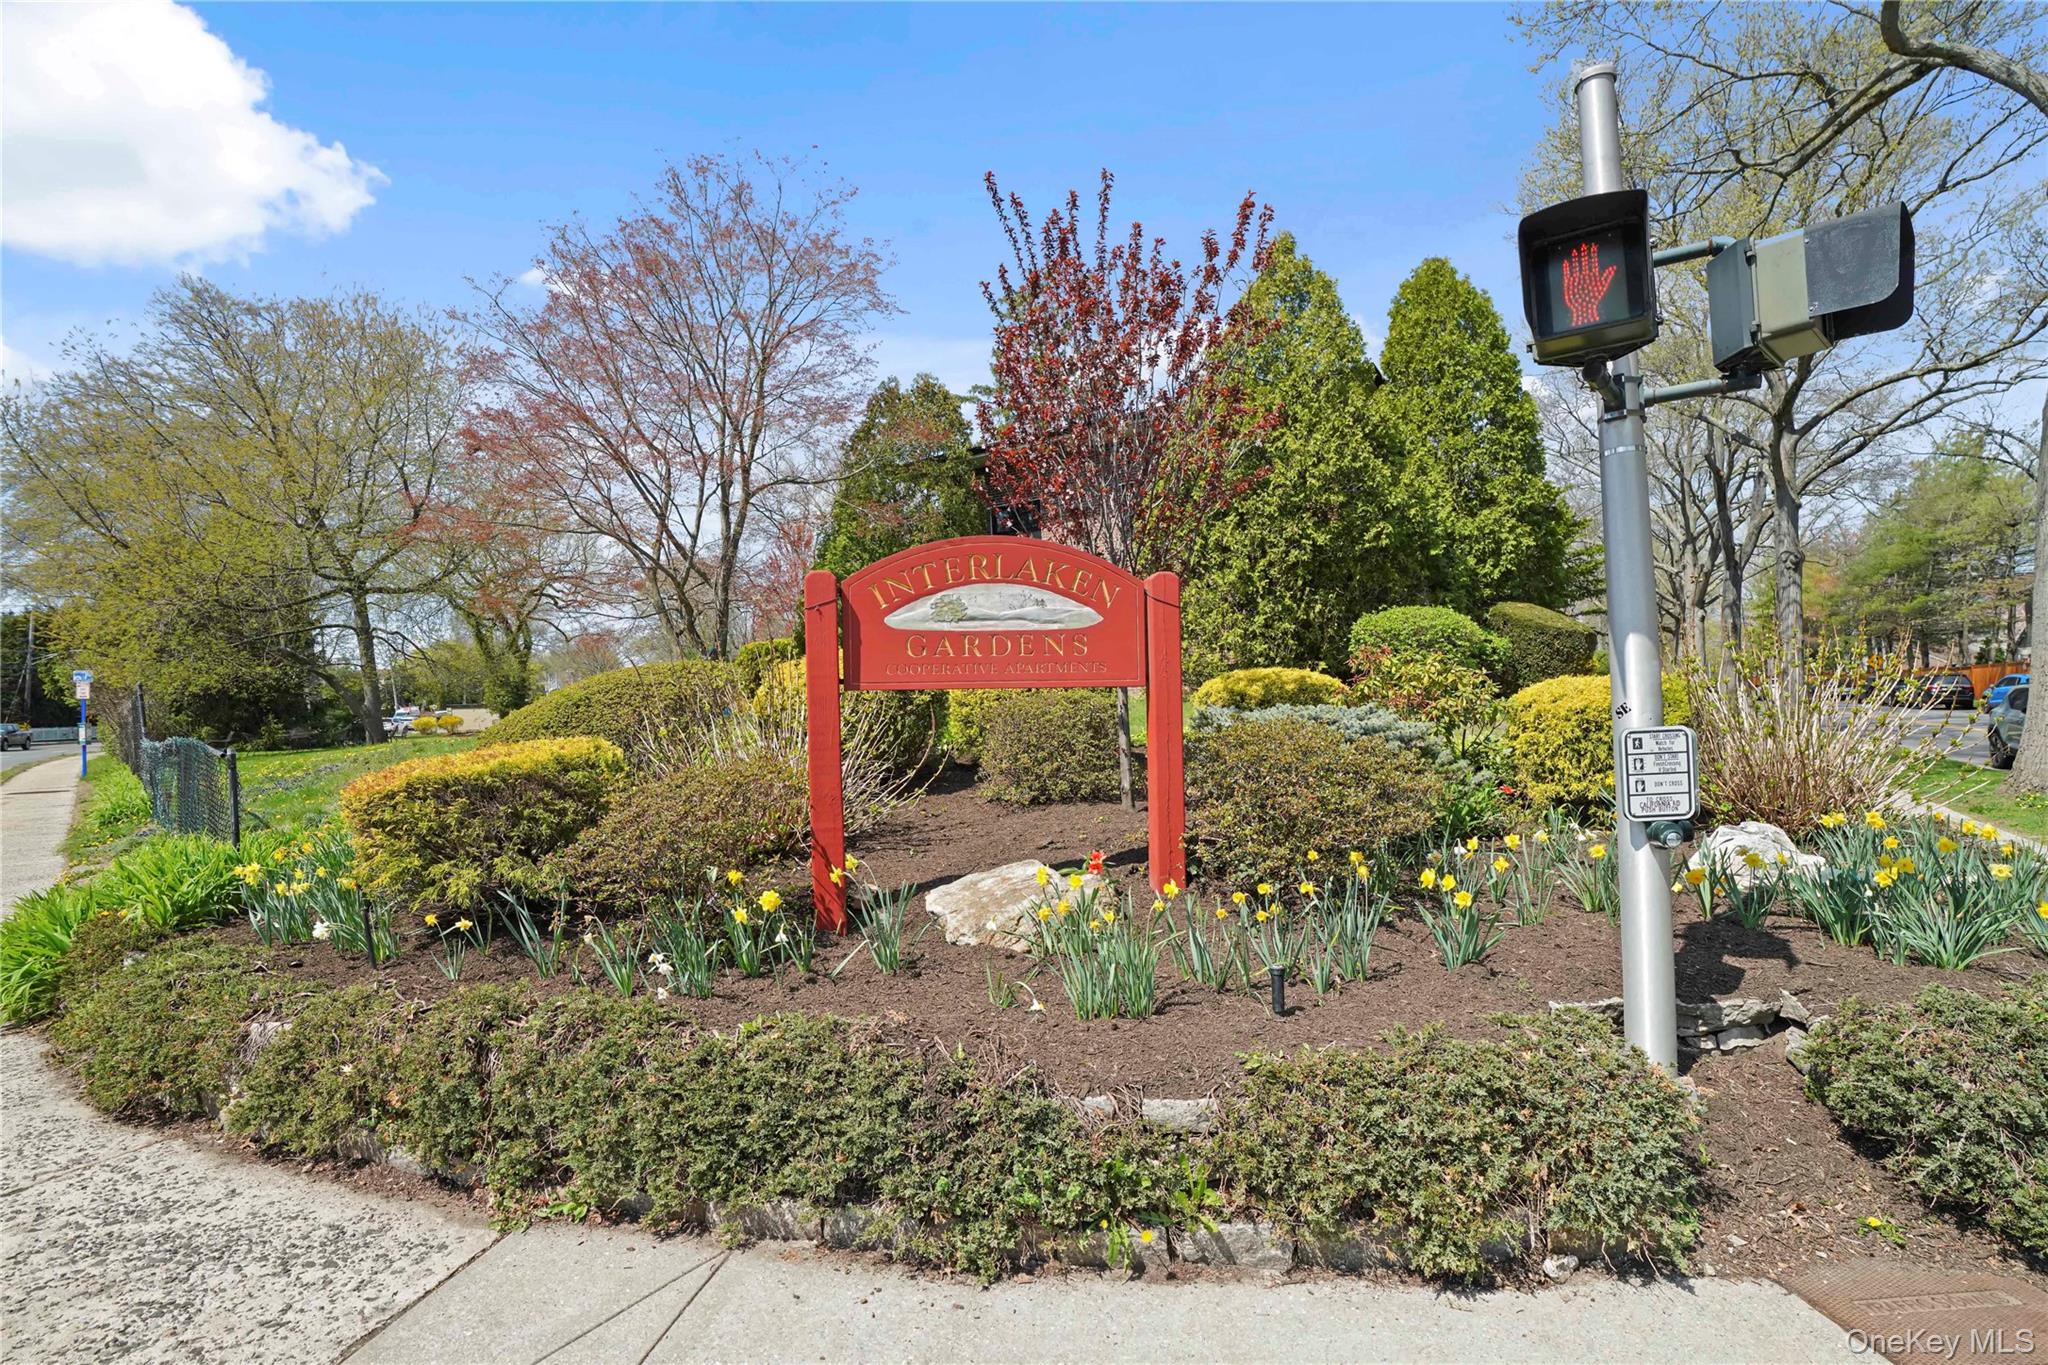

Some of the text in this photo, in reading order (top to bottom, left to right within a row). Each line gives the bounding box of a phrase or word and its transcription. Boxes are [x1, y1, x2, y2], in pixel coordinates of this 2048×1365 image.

[868, 552, 1121, 609] INTERLAKEN
[905, 633, 1089, 658] GARDENS
[886, 661, 1108, 676] COOPERATIVE APARTMENTS
[1615, 702, 1632, 719] SE
